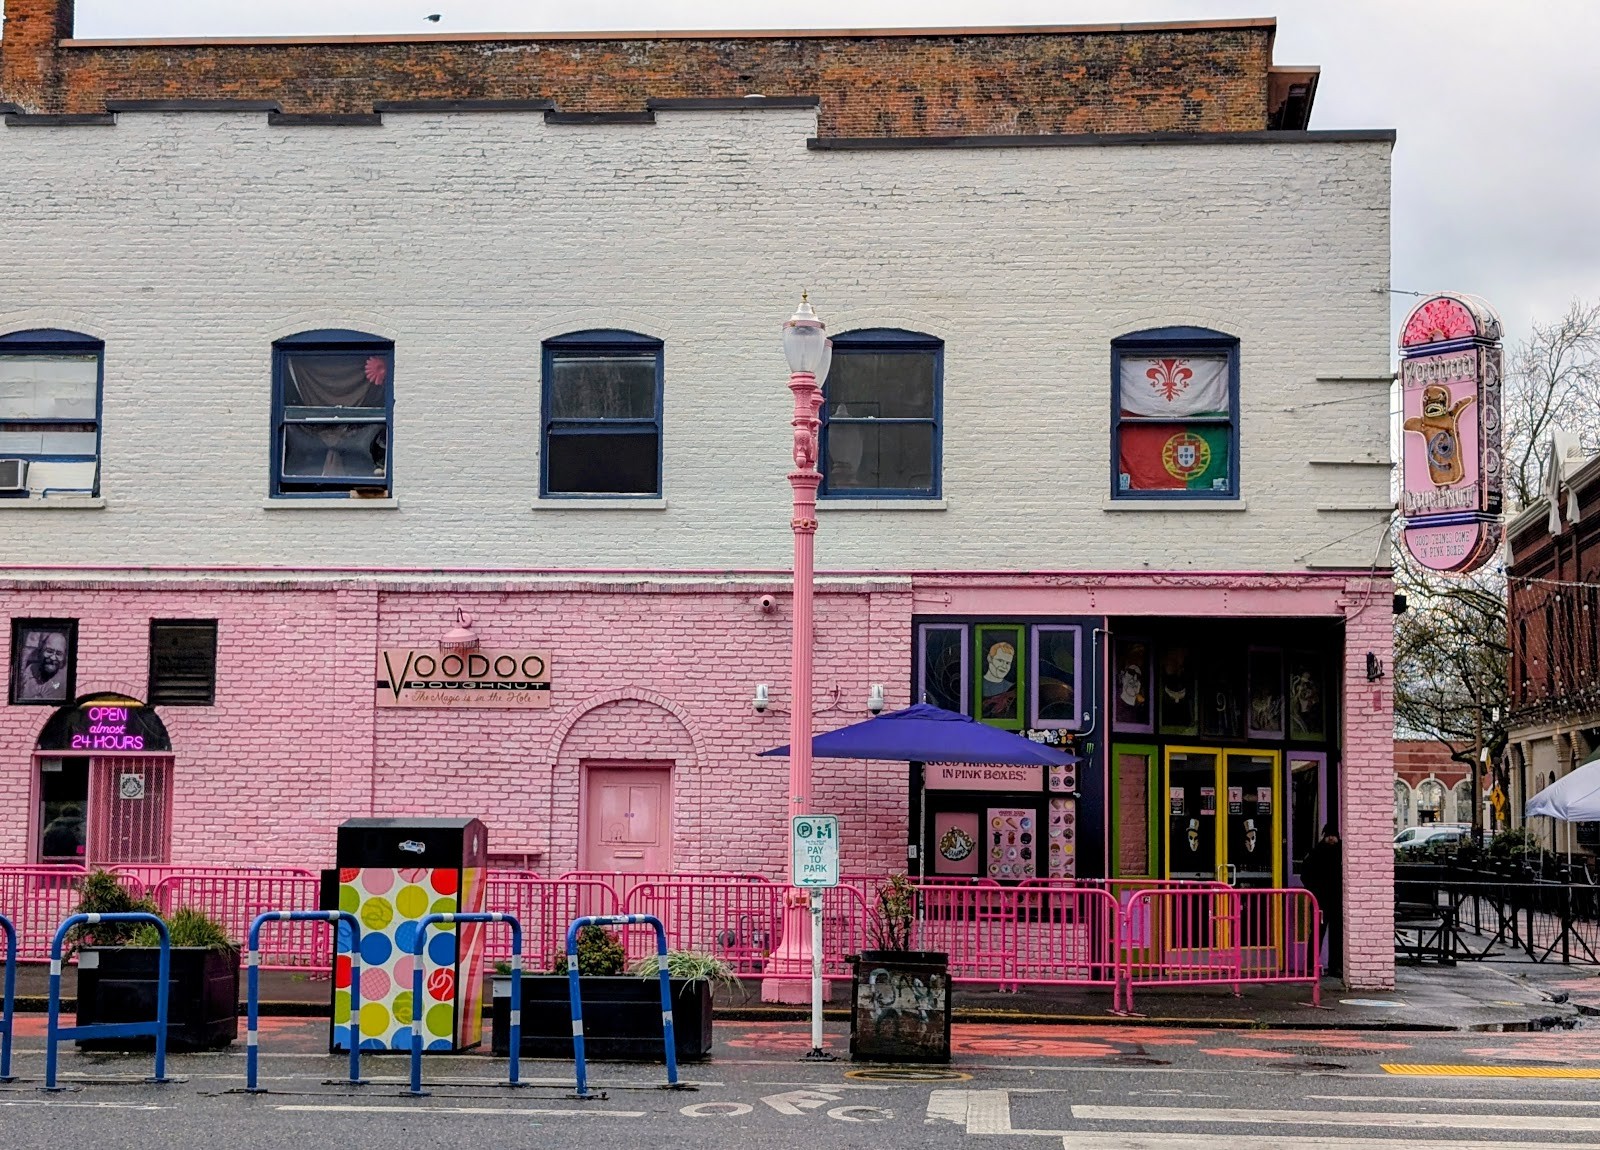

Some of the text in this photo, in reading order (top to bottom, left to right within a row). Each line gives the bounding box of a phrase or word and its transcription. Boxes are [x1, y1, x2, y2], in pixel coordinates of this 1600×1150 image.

[383, 651, 545, 703] VOODOO
[411, 681, 544, 690] DOUGHNUT
[412, 690, 532, 706] The Magic is in the Hole
[89, 707, 128, 721] OPEN
[89, 722, 126, 734] almost
[72, 735, 144, 750] 24 HOURS
[942, 768, 954, 779] IN
[955, 769, 982, 779] PINK
[807, 846, 823, 854] PAY
[809, 855, 821, 863] TO
[803, 864, 827, 872] PARK
